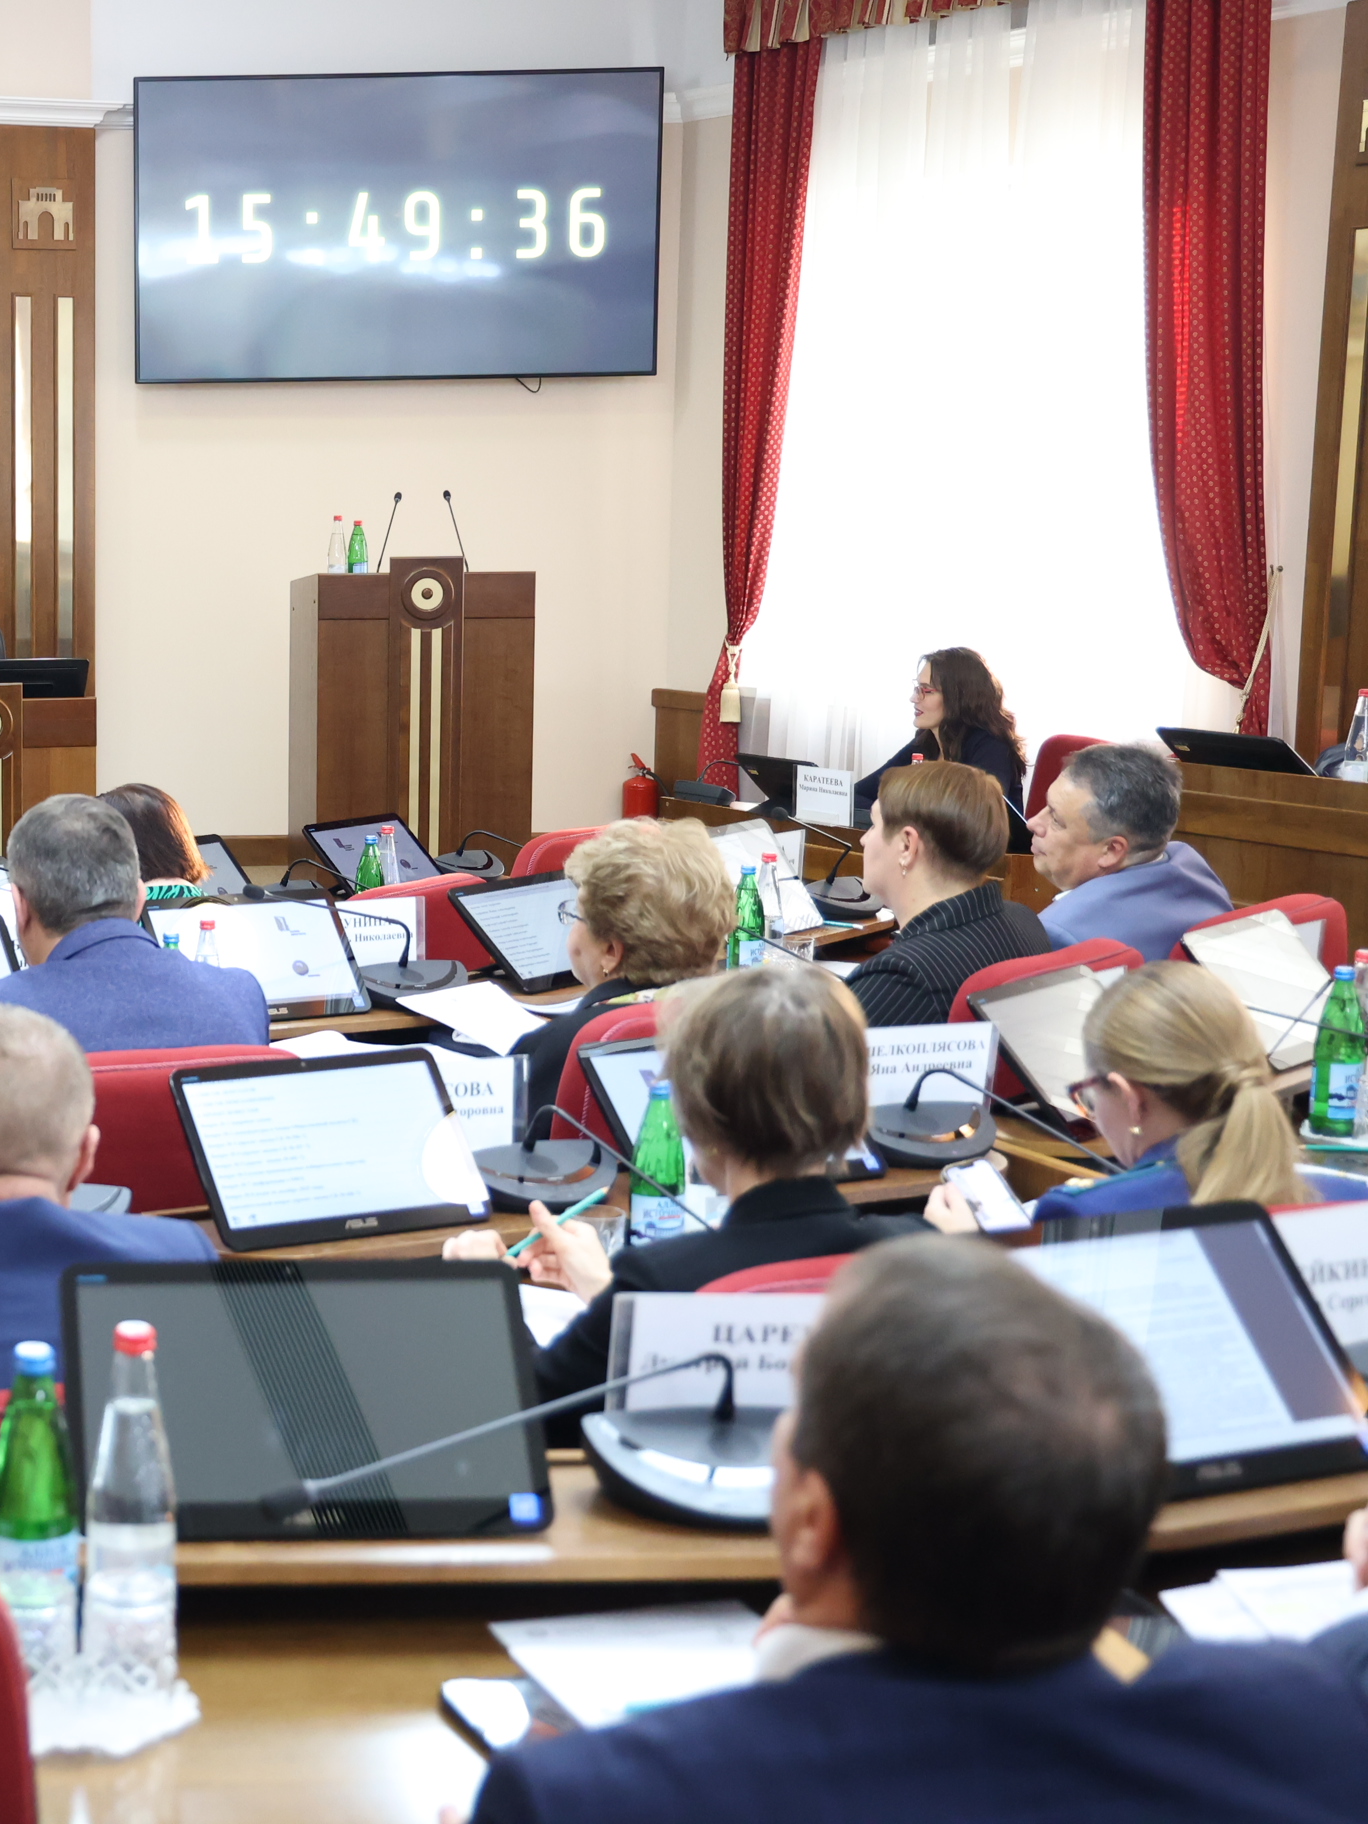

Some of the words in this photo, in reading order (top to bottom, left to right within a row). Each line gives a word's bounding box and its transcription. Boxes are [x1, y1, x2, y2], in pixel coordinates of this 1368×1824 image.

[183, 186, 607, 265] 15:49:36
[803, 774, 844, 787] КАРАТЕЕВА
[799, 784, 818, 792] Марина
[818, 787, 848, 797] Николаевна
[870, 1062, 897, 1075] Яна
[900, 1060, 973, 1073] Андреевна
[345, 1217, 379, 1229] ASUS
